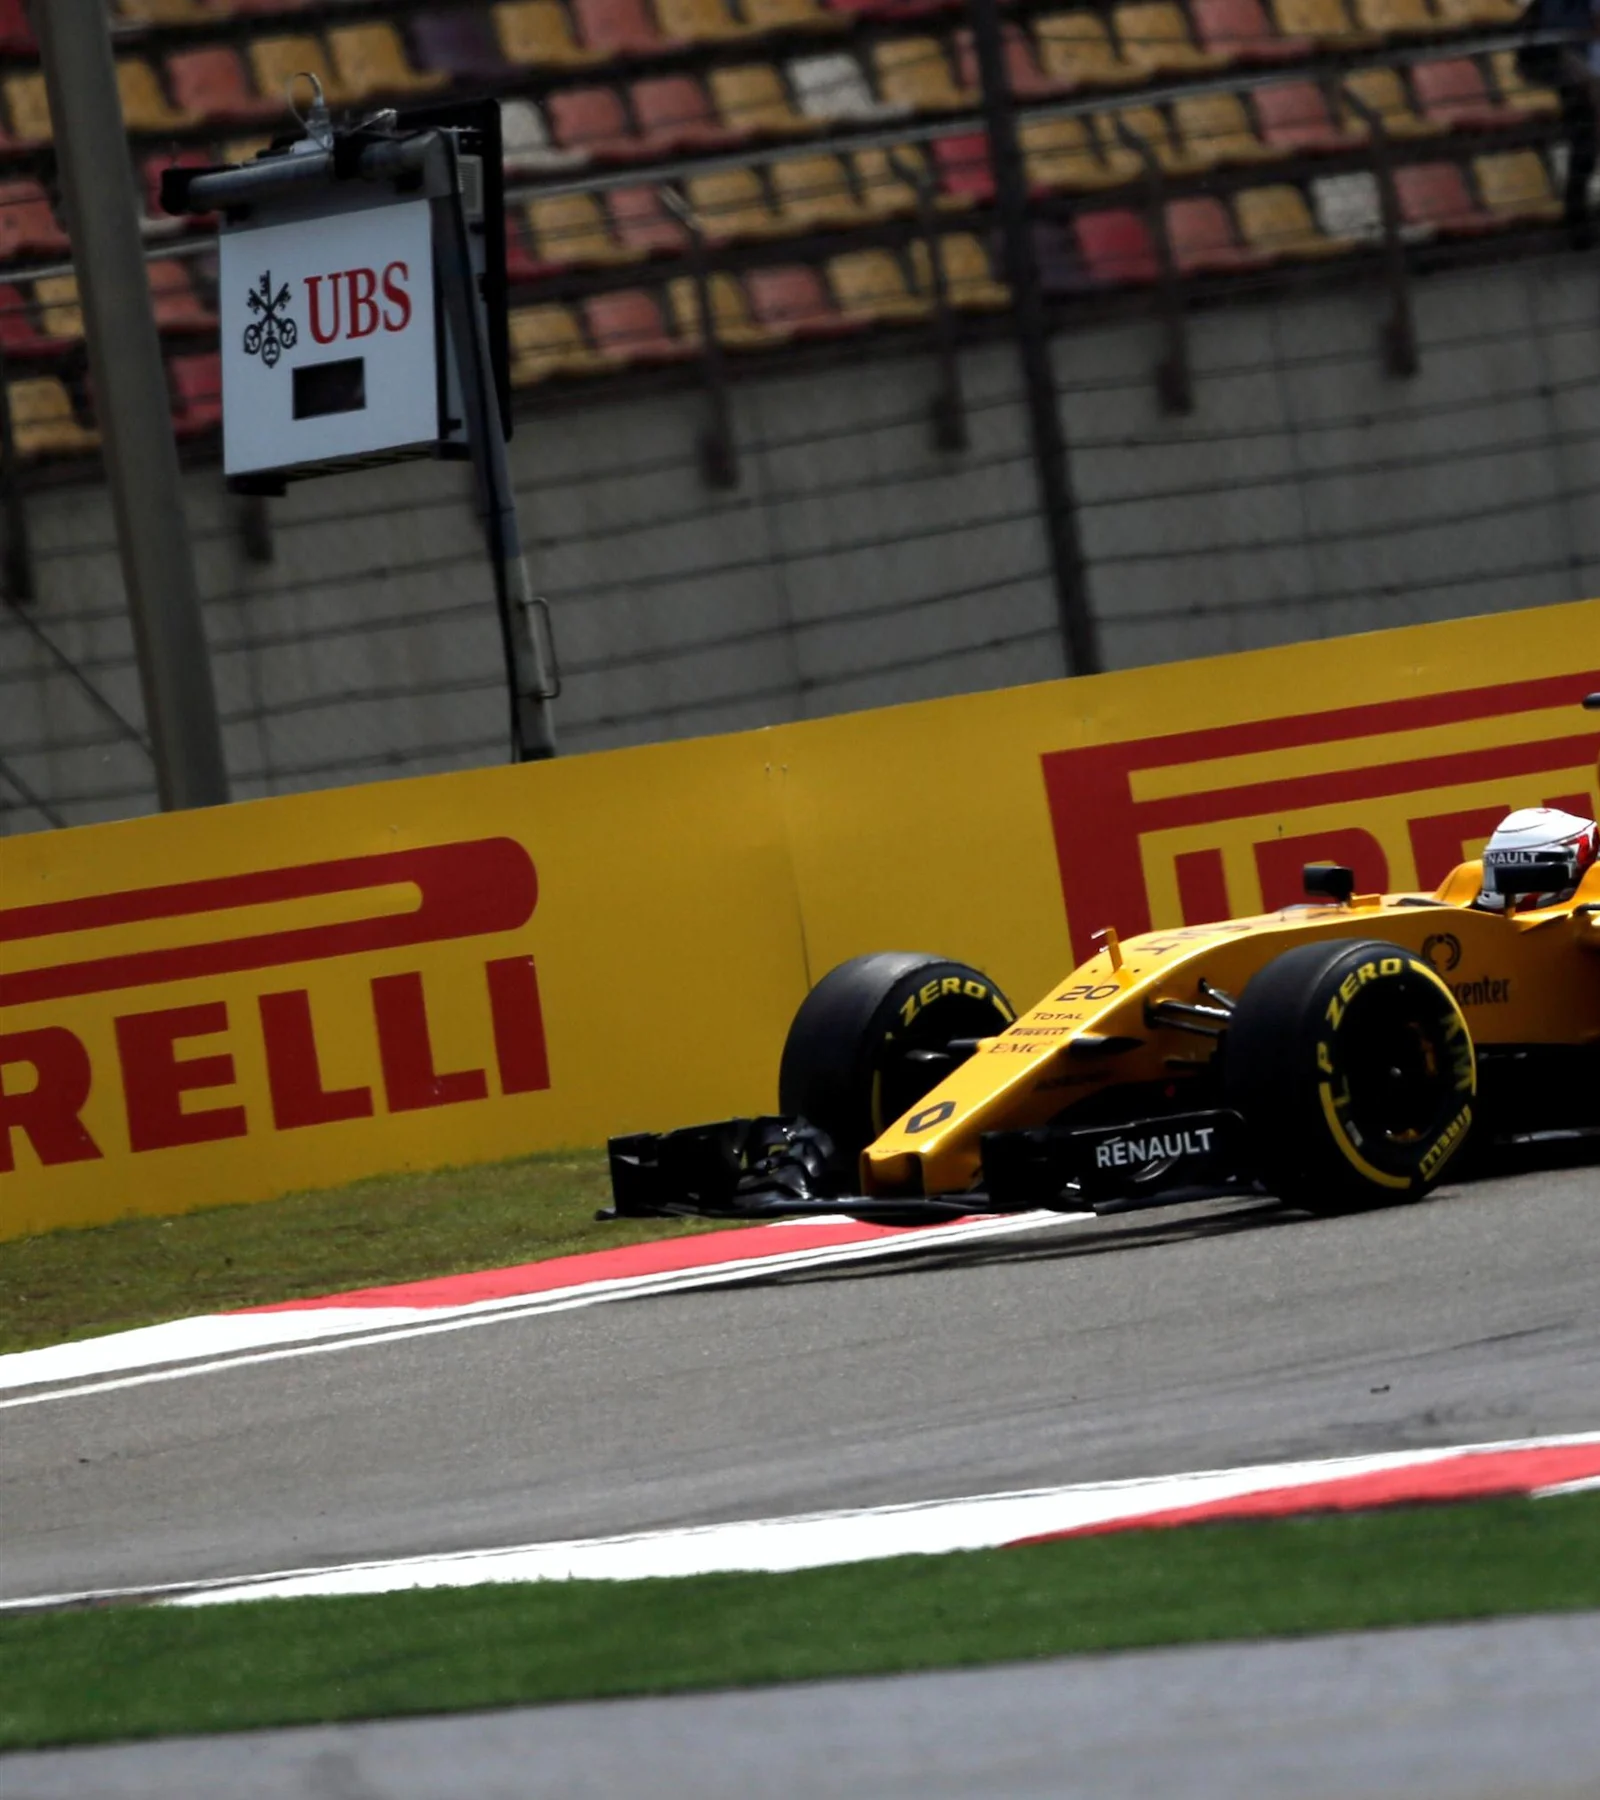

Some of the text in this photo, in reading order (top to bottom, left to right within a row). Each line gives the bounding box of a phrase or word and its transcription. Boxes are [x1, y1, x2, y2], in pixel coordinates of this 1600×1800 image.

[304, 260, 412, 345] UBS
[1485, 852, 1539, 865] NAULT
[900, 976, 988, 1027] ZERO
[1055, 984, 1120, 1002] 20
[1325, 957, 1404, 1032] ZERO
[1449, 975, 1512, 1006] center
[1033, 1012, 1084, 1021] TOTAL
[0, 954, 550, 1174] RELLI
[1095, 1127, 1215, 1169] RENAULT
